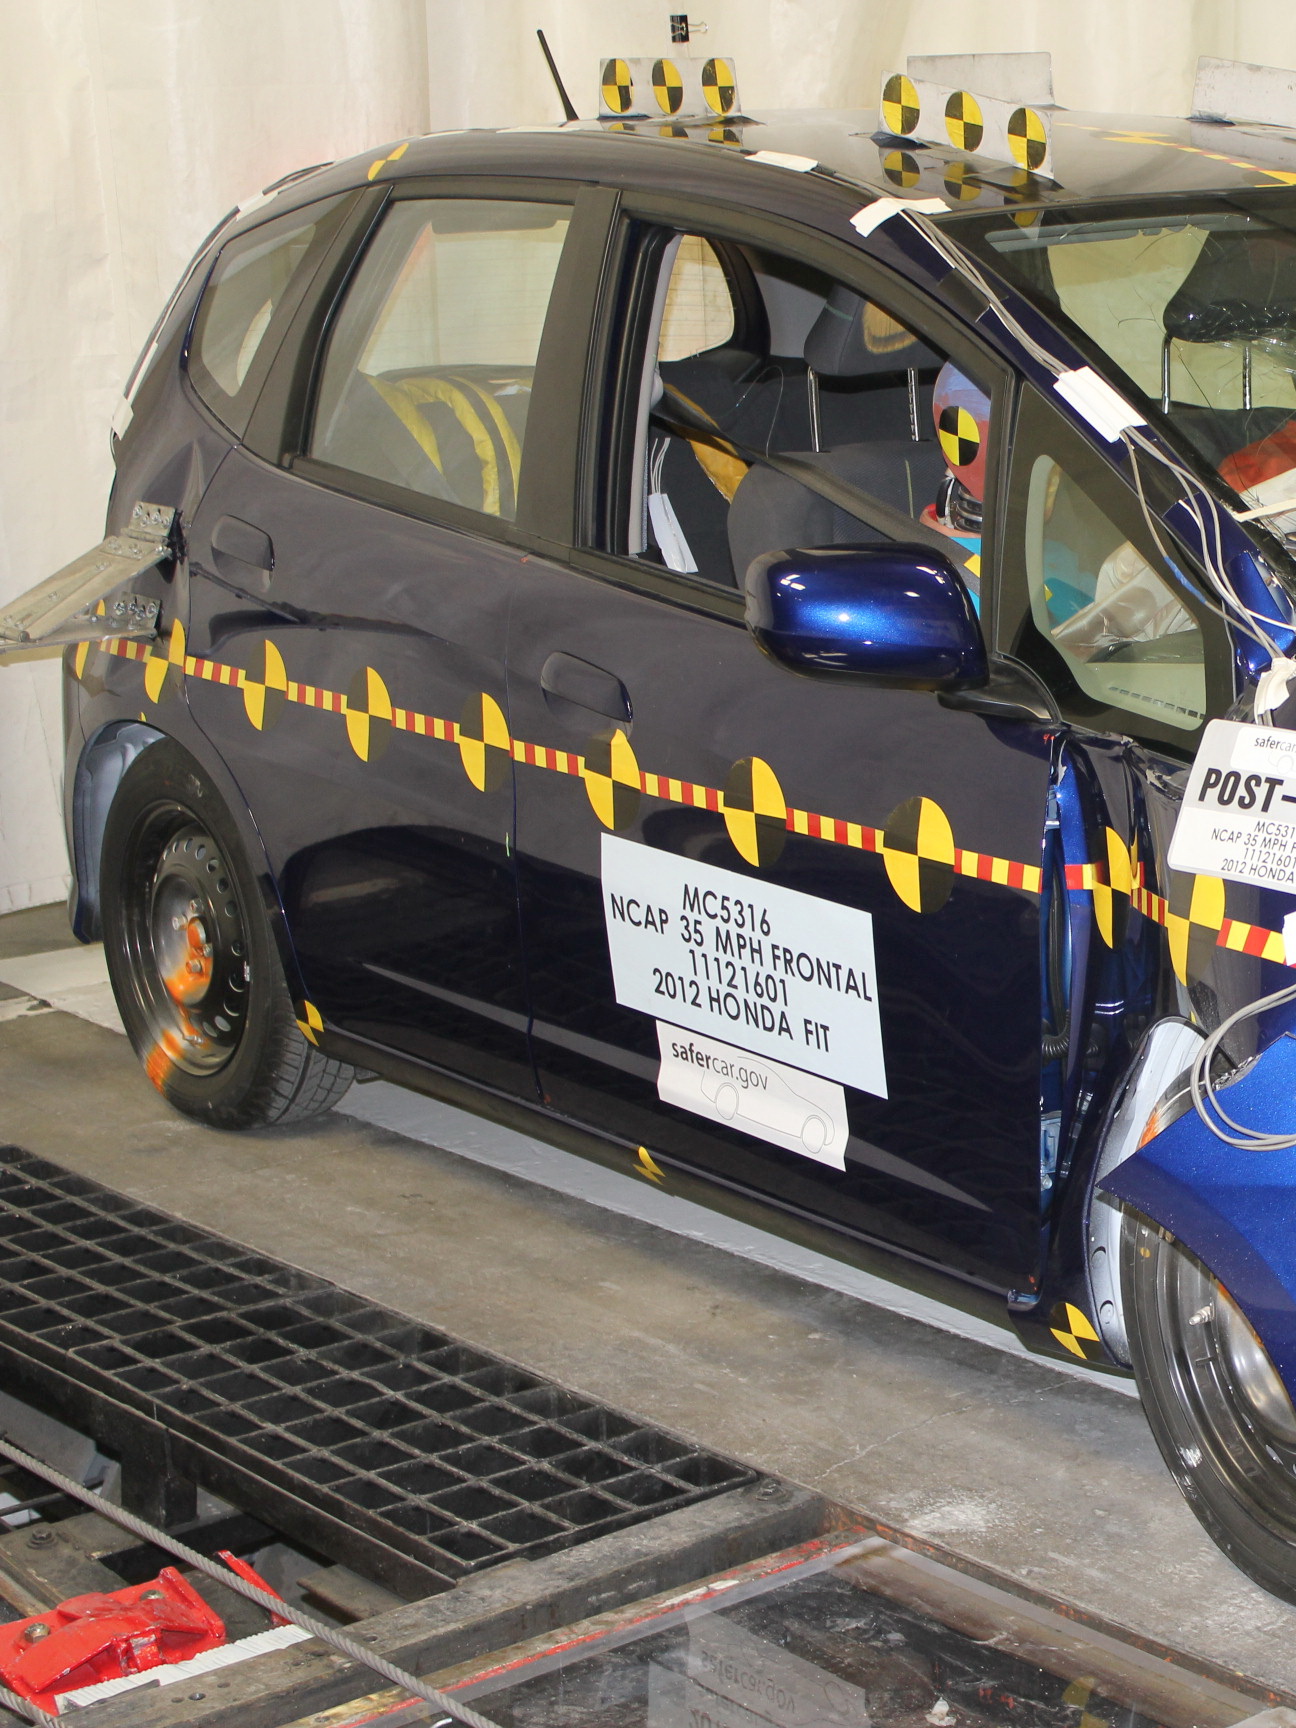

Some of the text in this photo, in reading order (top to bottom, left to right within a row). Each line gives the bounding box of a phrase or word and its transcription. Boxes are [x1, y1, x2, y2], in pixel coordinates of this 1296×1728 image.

[1211, 828, 1243, 844] NCAP
[1243, 834, 1259, 847] 35
[1260, 836, 1287, 852] MPH
[1220, 858, 1247, 874] 2012
[1249, 863, 1295, 885] HONDA
[682, 883, 771, 937] MC5316
[610, 892, 873, 1003] NCAP 35 MPH FRONTAL
[688, 948, 789, 1007] 11121601
[652, 967, 830, 1053] 2012 HONDA FIT
[671, 1040, 768, 1091] safercar.gov
